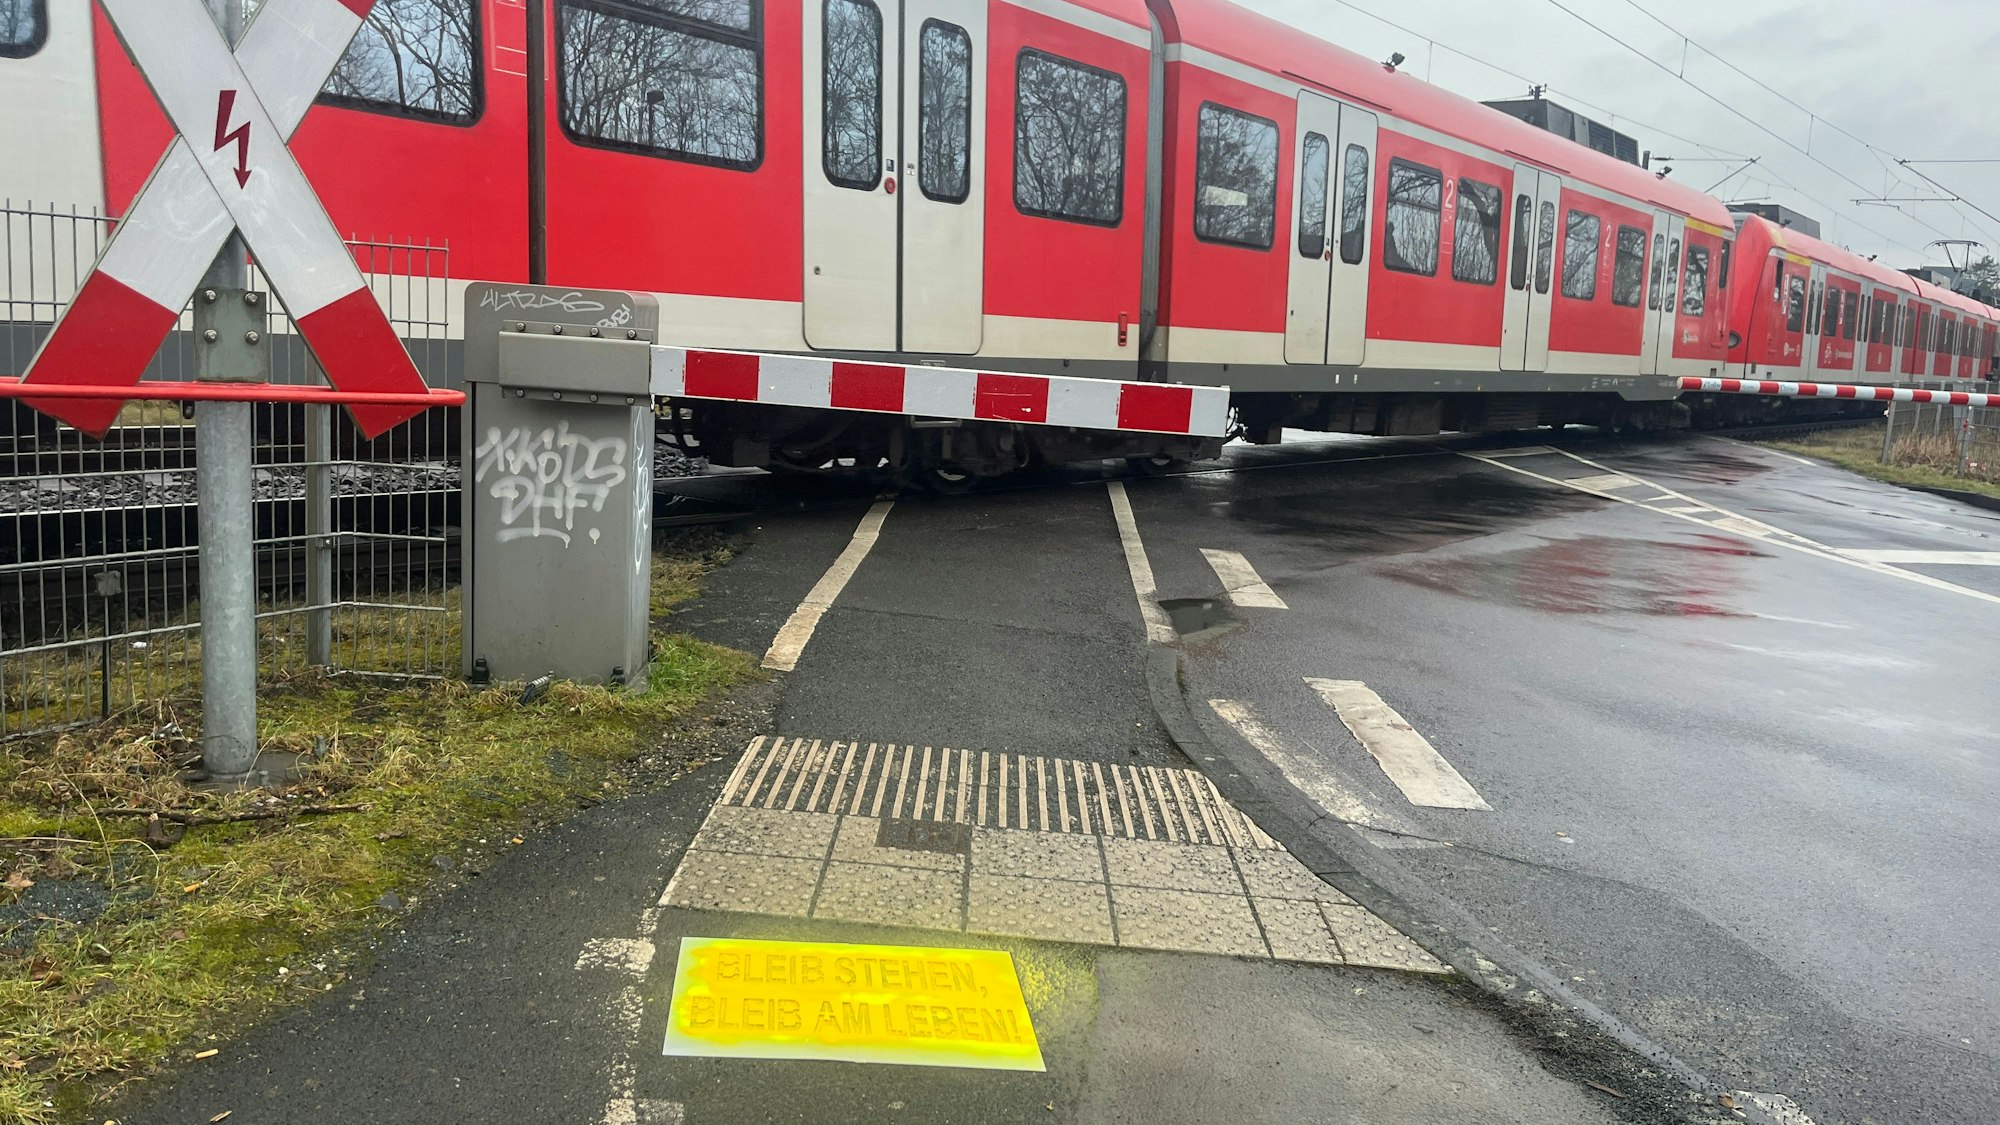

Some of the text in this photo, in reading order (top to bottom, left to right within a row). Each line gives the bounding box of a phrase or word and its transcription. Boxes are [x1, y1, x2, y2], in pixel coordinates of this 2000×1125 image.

[1444, 178, 1454, 209] 2
[1604, 223, 1612, 248] 2
[717, 952, 988, 998] BLEIB STEHEN,
[689, 995, 1022, 1044] BLEIB AM LEBEN!
